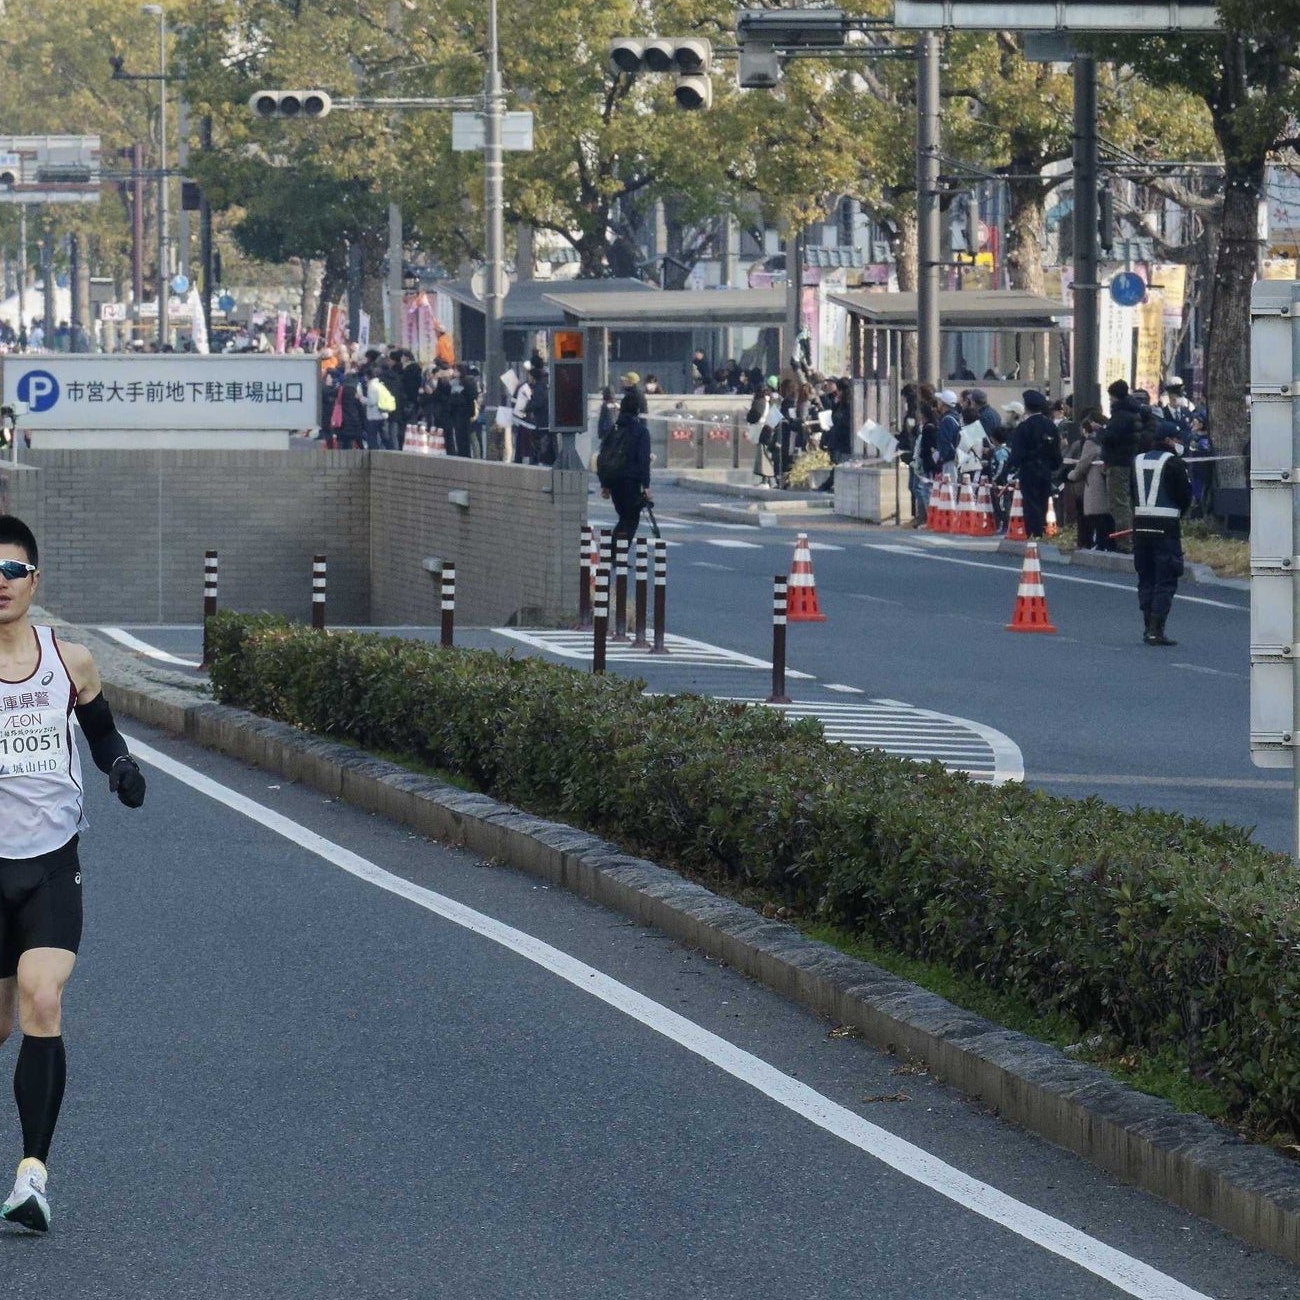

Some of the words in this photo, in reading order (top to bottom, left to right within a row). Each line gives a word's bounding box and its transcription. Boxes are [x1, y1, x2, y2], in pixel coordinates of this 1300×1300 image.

[66, 380, 304, 404] 市営大手前地下駐車場出口
